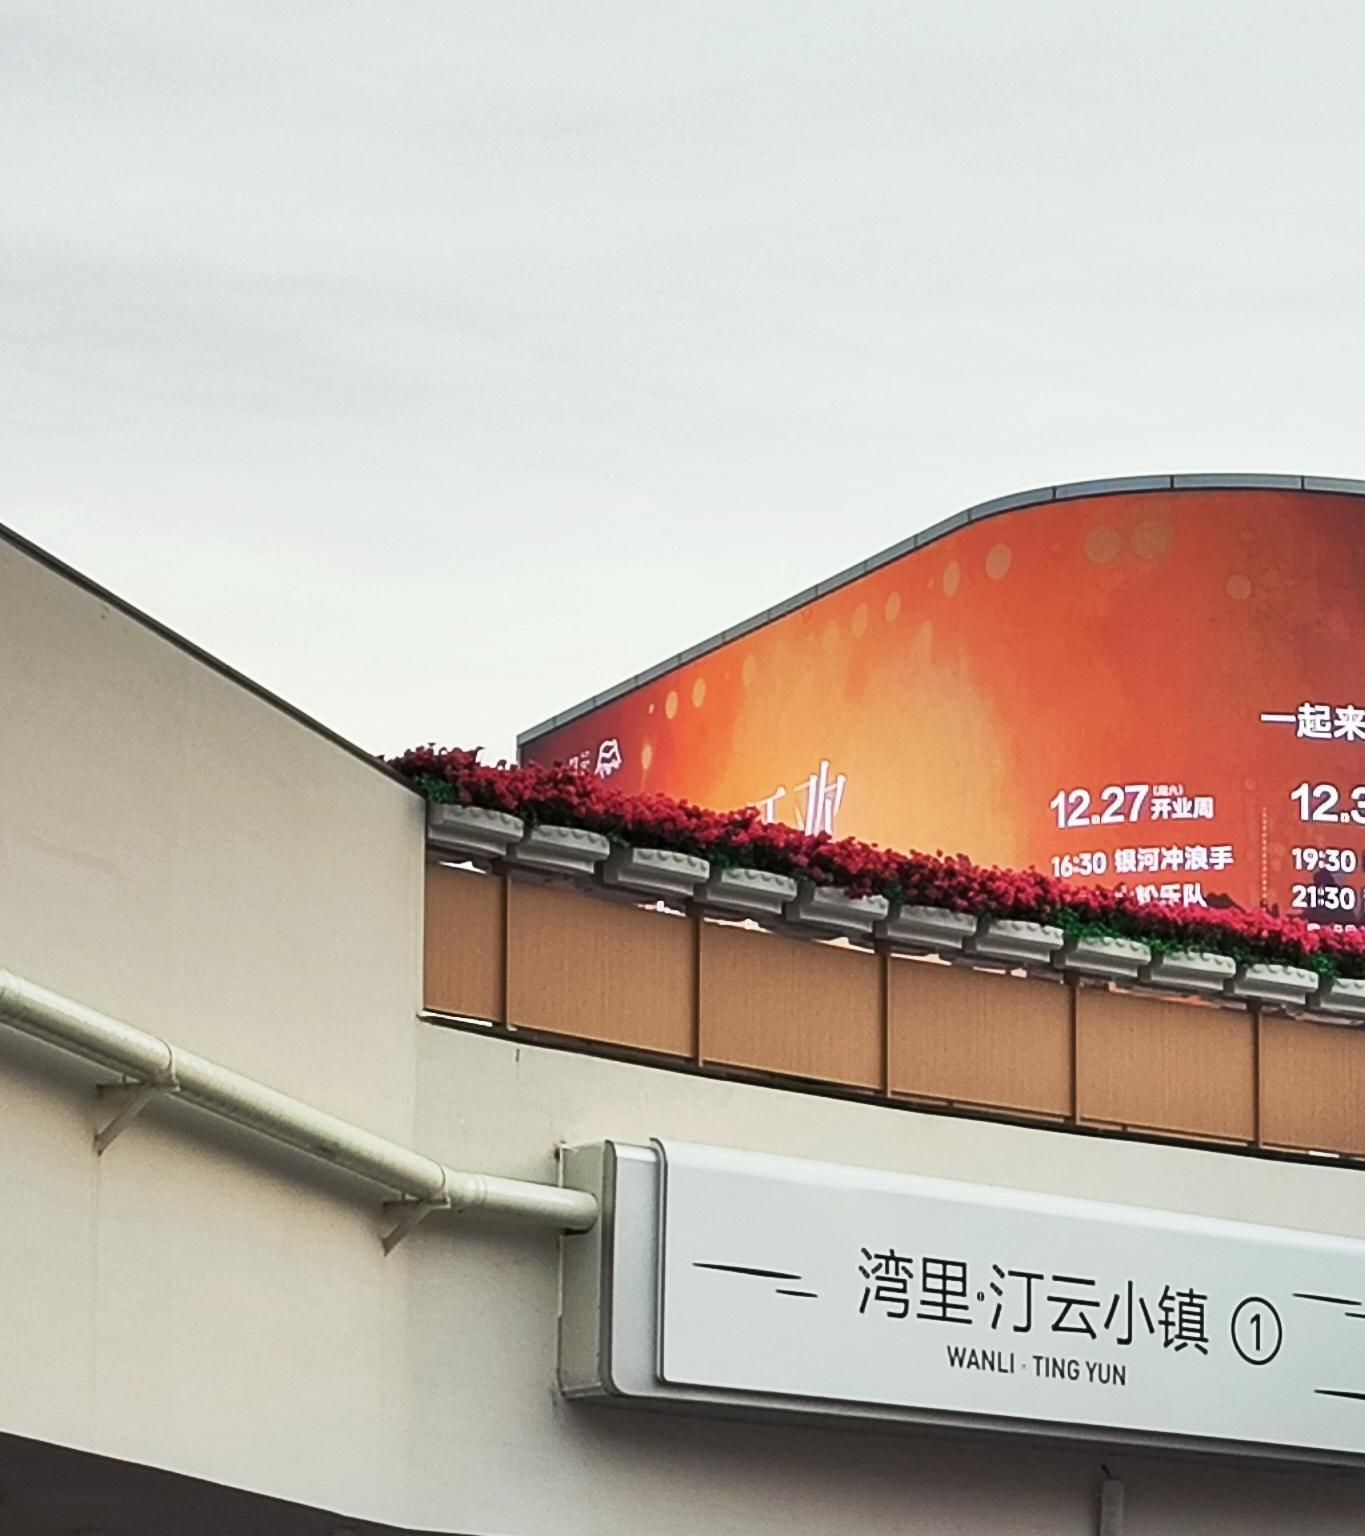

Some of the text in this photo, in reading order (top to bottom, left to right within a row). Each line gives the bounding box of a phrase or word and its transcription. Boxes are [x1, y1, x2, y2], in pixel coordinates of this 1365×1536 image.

[1050, 784, 1215, 829] 12.27 开业周
[1051, 845, 1235, 878] 16:30 银河冲浪手
[1291, 847, 1357, 873] 19:30
[1291, 884, 1356, 910] 21:30
[945, 1344, 1128, 1386] WANLI TING YUN
